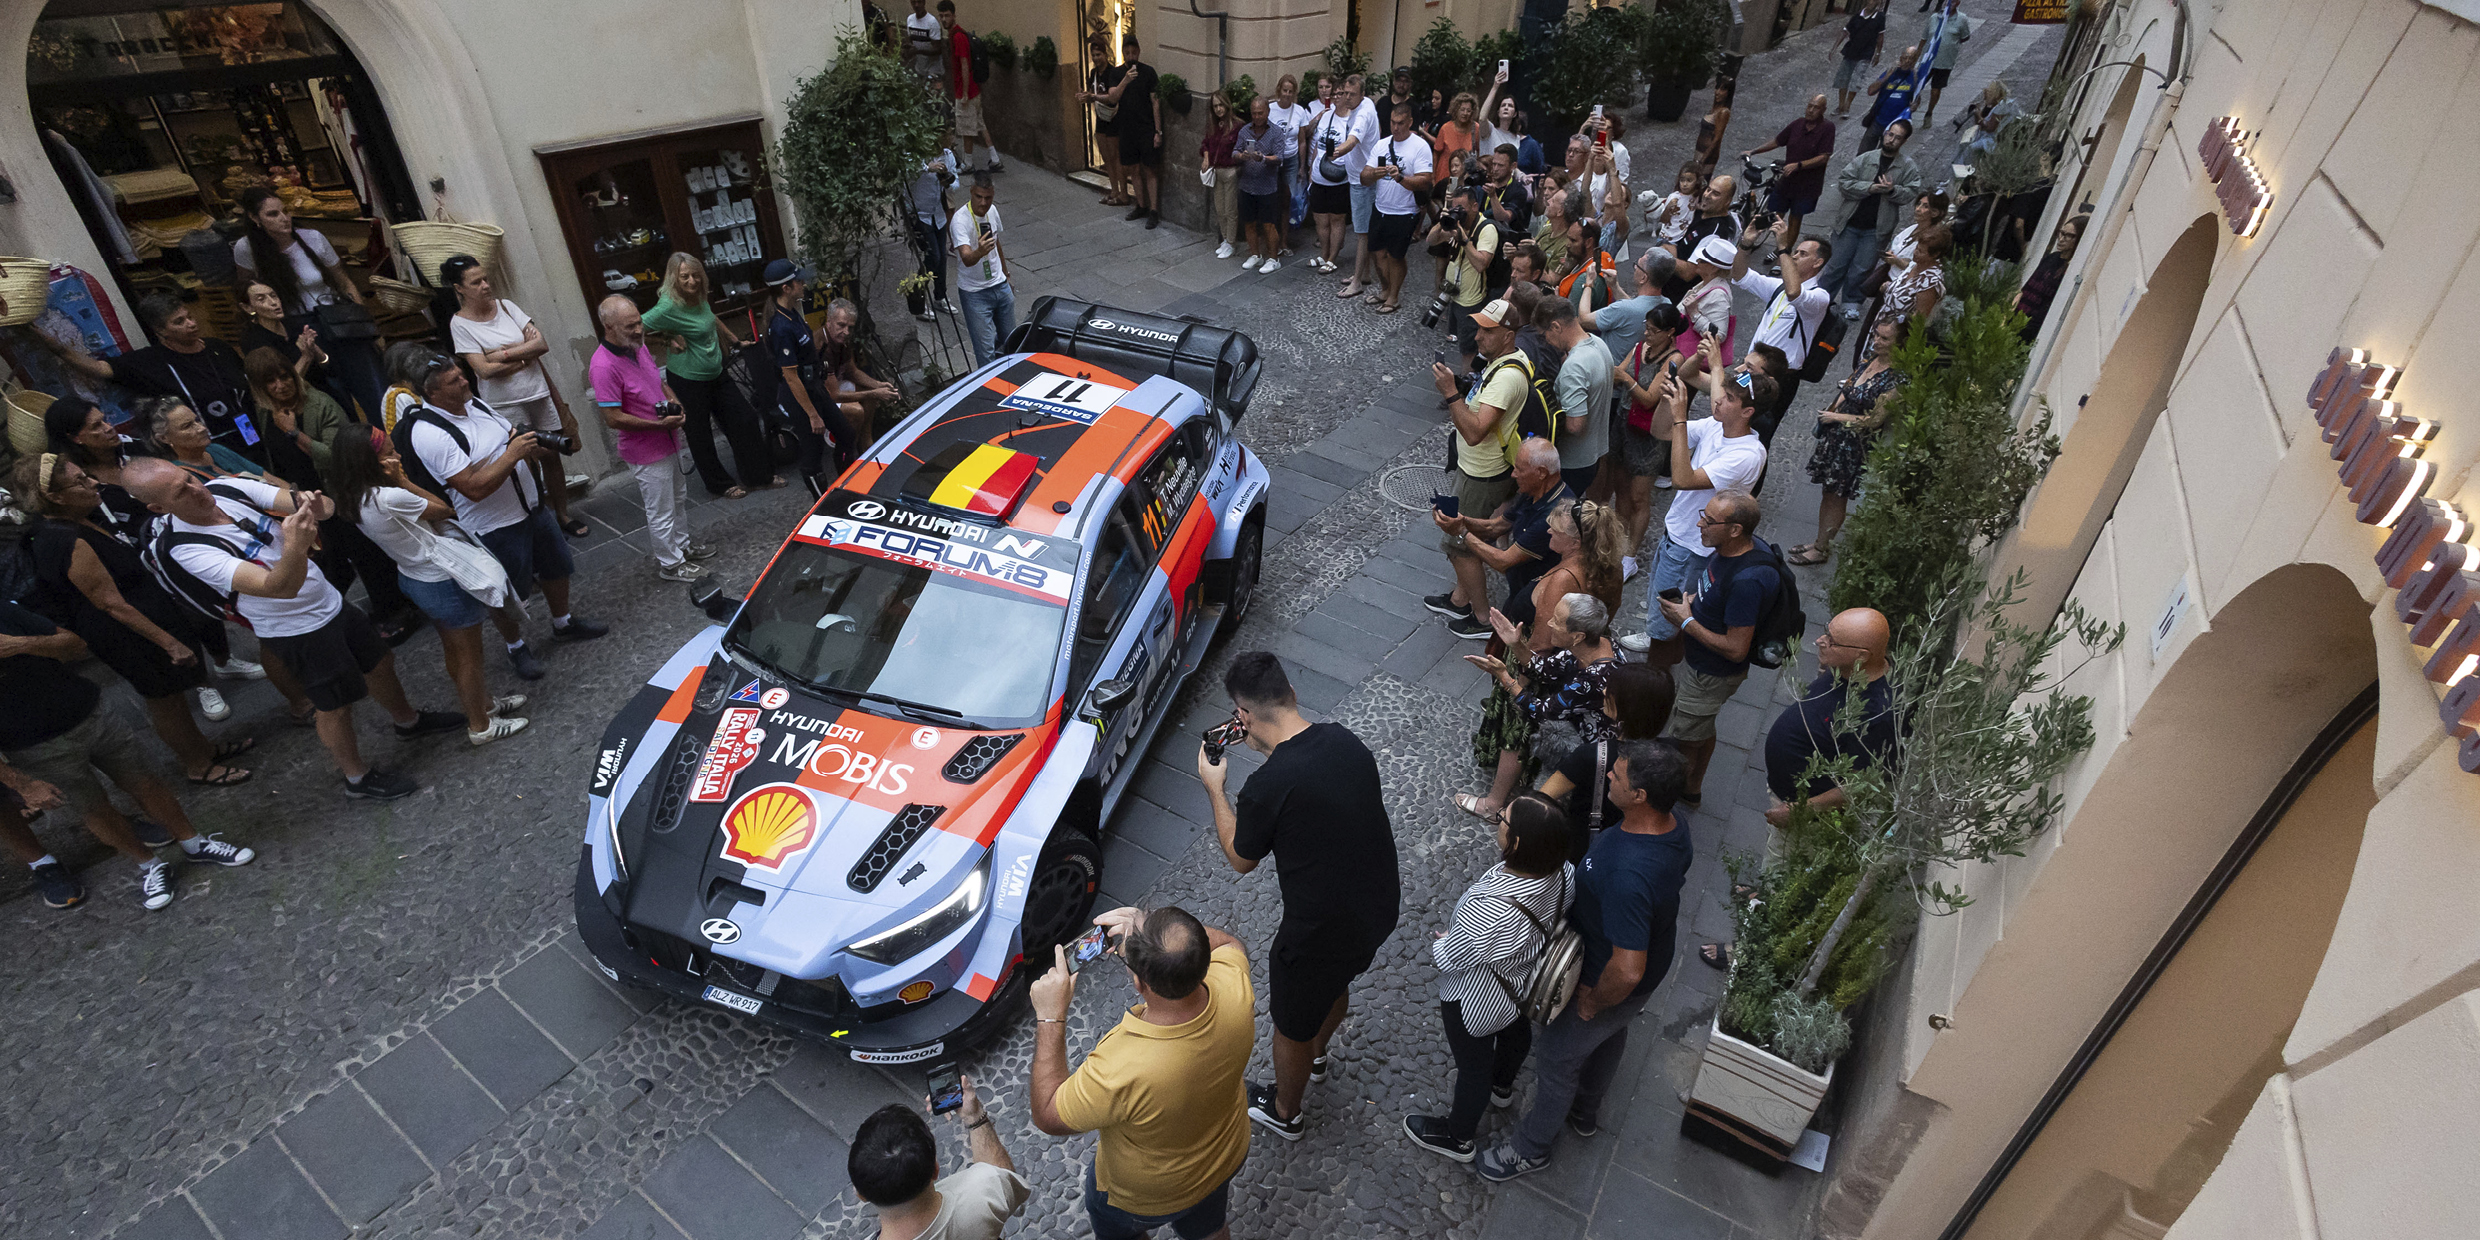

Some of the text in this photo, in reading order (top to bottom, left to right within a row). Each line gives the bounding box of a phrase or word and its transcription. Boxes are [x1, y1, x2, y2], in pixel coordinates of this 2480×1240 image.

[2024, 7, 2069, 19] GASTRONO
[1118, 325, 1178, 343] HYUNDA
[1012, 398, 1093, 420] SARDEGNA
[1043, 379, 1092, 403] 11
[1160, 457, 1187, 502] T. Neuville
[889, 509, 989, 543] HYUNDAI
[1142, 504, 1163, 550] 11
[853, 526, 1048, 589] FORUM8
[883, 552, 967, 577] フォーラムエイト
[1064, 551, 1092, 660] motorsport.hyundai.com
[767, 692, 782, 704] E
[720, 712, 748, 750] RALLY
[750, 732, 759, 740] 11
[769, 710, 865, 744] HYUNDAI
[918, 731, 933, 745] E
[594, 749, 616, 788] WIA
[611, 737, 628, 775] HYUNDAI
[698, 726, 726, 779] SARDEGNA
[729, 742, 744, 764] 2026
[768, 733, 915, 796] MOBIS
[701, 753, 730, 795] ITALIA
[996, 869, 1012, 909] HYUNDAI
[1007, 854, 1033, 897] WIA
[709, 989, 759, 1011] ALZ WR 917
